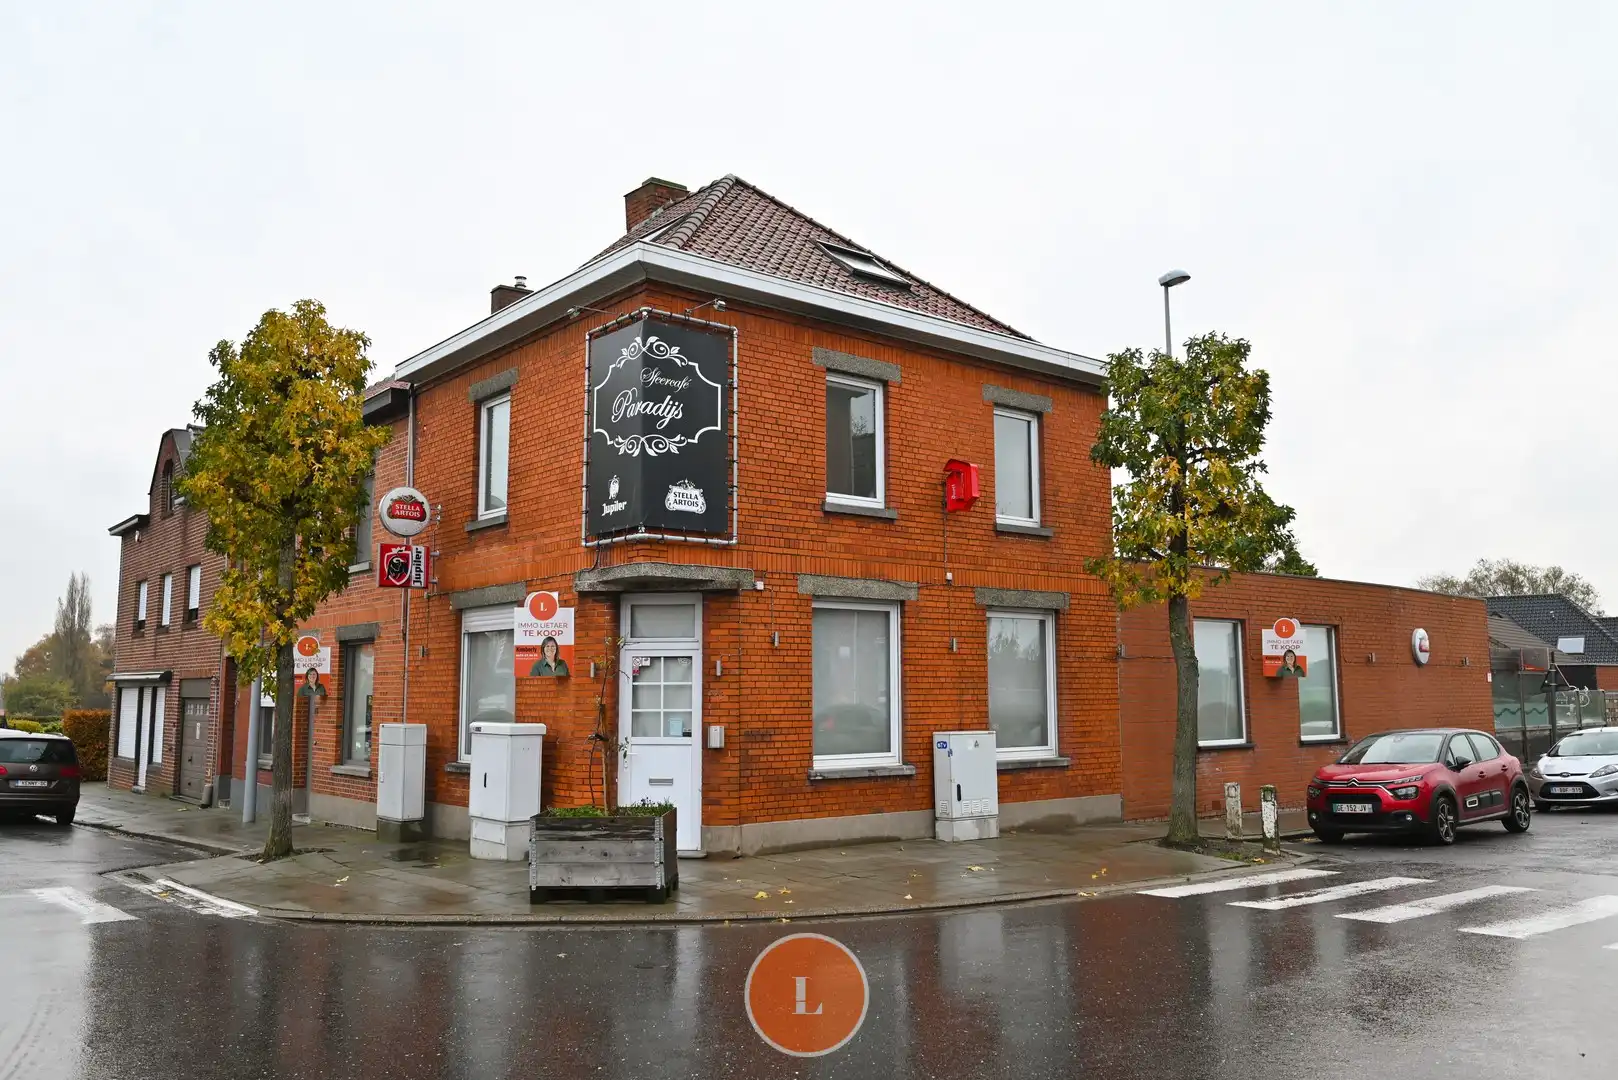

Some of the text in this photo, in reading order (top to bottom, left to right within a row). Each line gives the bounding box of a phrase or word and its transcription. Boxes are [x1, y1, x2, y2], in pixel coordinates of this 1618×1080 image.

[640, 367, 692, 393] Sfeercafé
[611, 388, 683, 429] Paradijs
[673, 492, 698, 500] STELLA
[673, 499, 699, 507] ARTOIS
[601, 501, 627, 516] Jupiler
[413, 547, 423, 585] Jupiler
